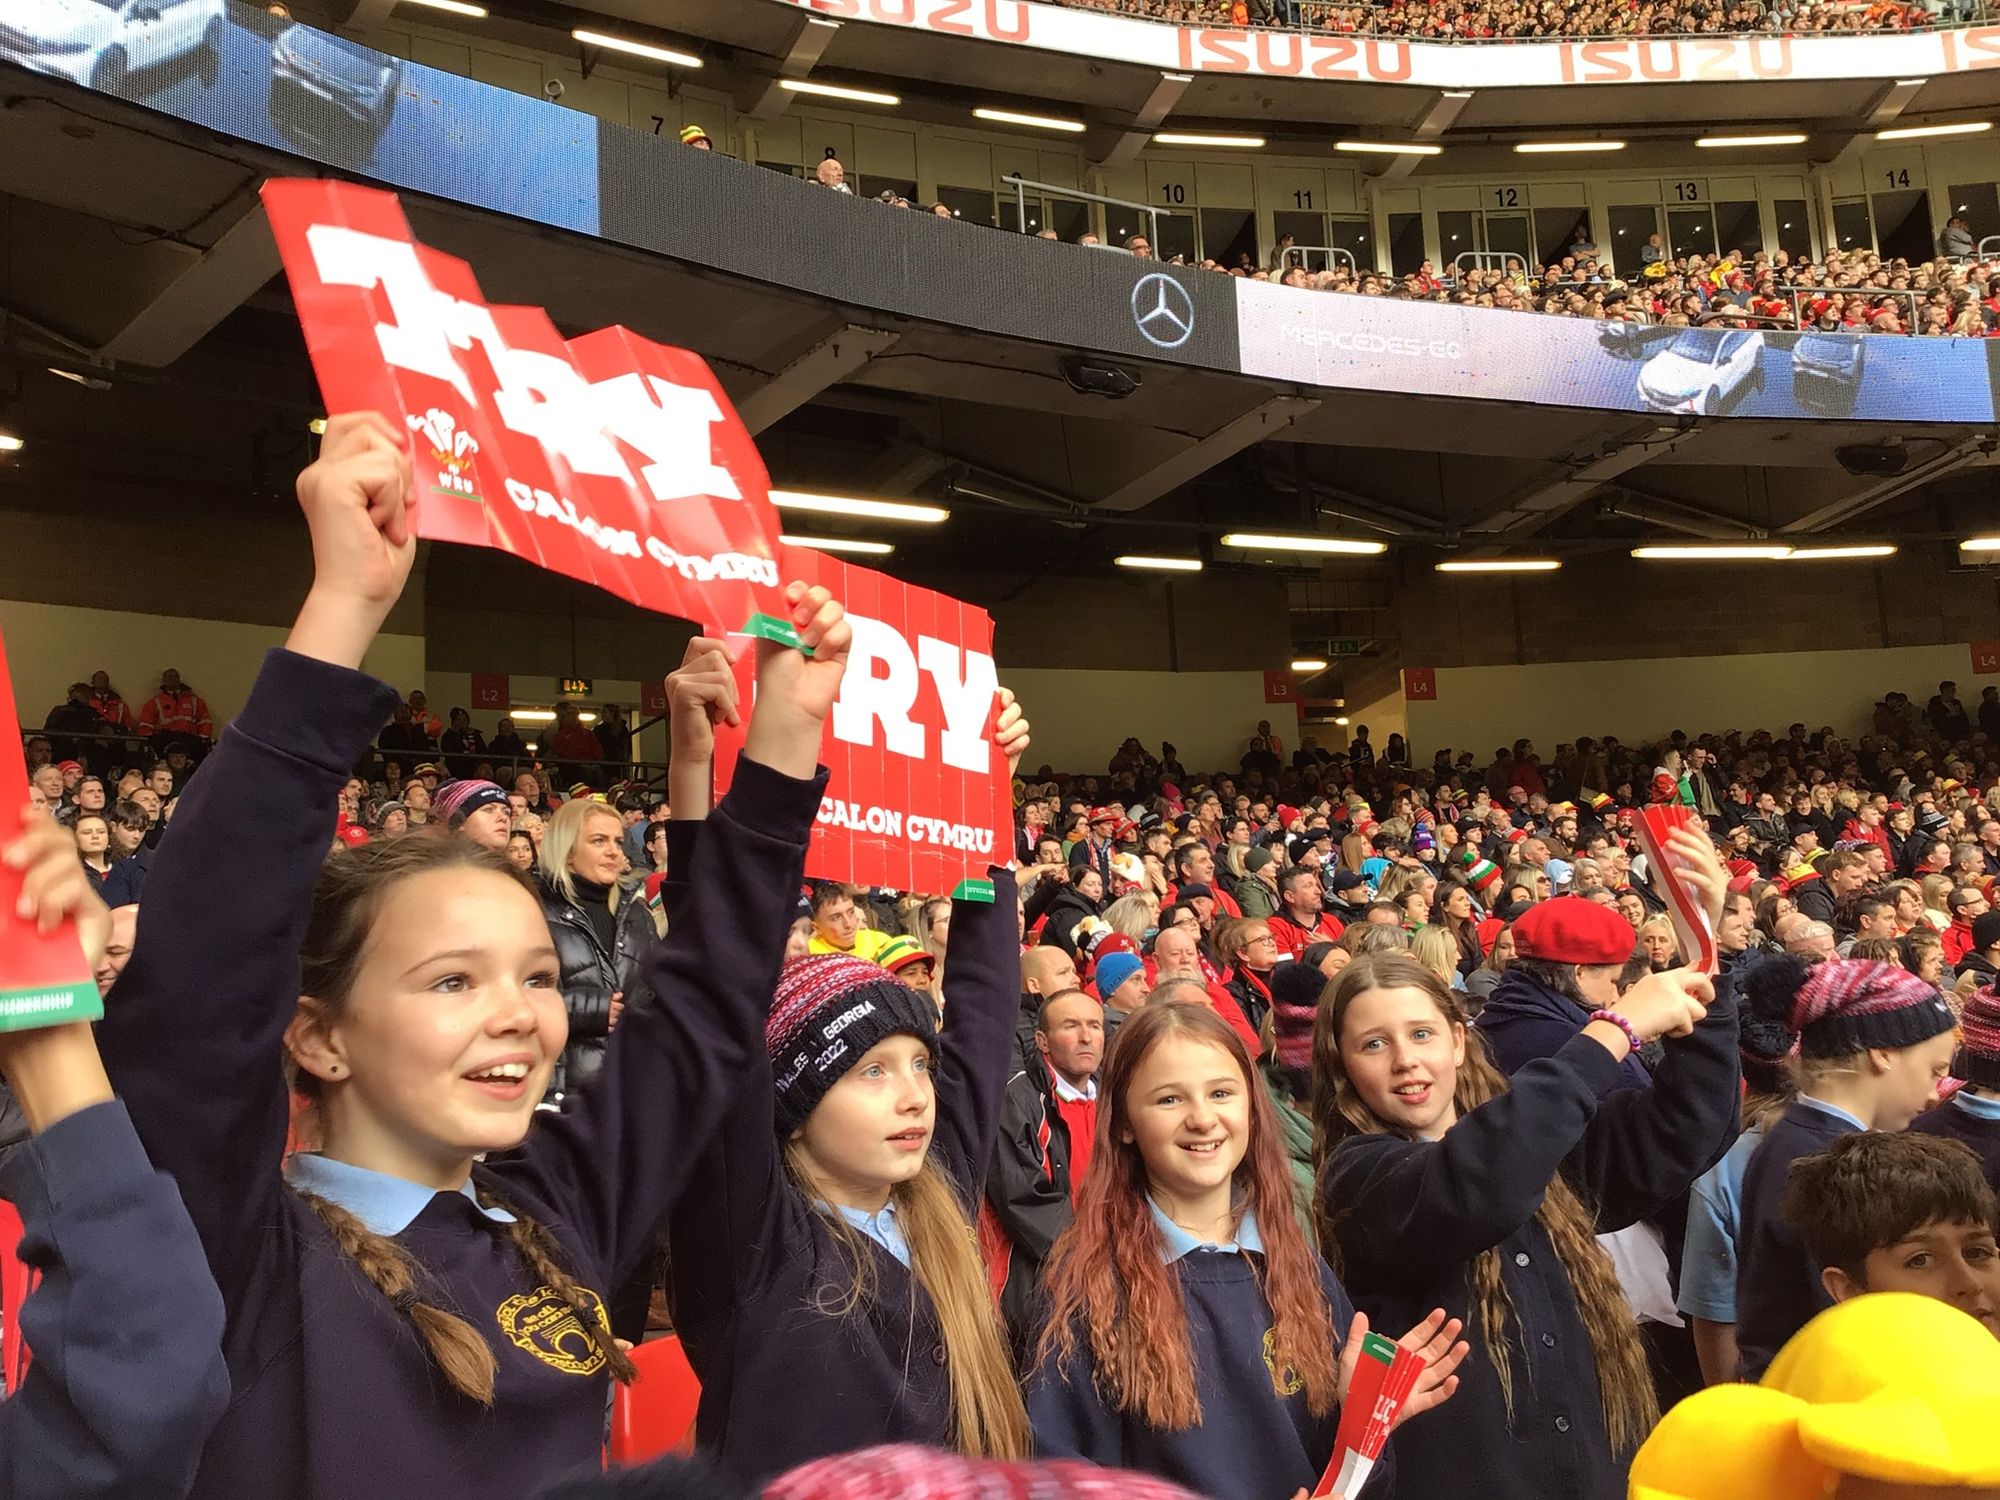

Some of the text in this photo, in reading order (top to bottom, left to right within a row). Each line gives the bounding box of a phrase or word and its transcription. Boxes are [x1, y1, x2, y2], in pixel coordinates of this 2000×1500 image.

[790, 0, 1029, 42] UZU
[1177, 28, 1411, 81] ISUZU
[1559, 40, 1793, 82] ISUZU
[651, 116, 663, 135] 7
[1886, 169, 1910, 188] 14
[1162, 184, 1185, 203] 10
[1293, 190, 1312, 209] 11
[1494, 188, 1518, 207] 12
[1675, 182, 1698, 201] 13
[306, 223, 743, 502] TRY
[437, 471, 474, 494] WRU
[482, 689, 498, 701] L2
[753, 612, 999, 774] RY
[1273, 684, 1287, 696] L3
[1413, 682, 1428, 693] L4
[816, 796, 994, 853] CALON CYMRU
[822, 1000, 876, 1040] GEORGIA
[814, 1038, 848, 1072] 2022
